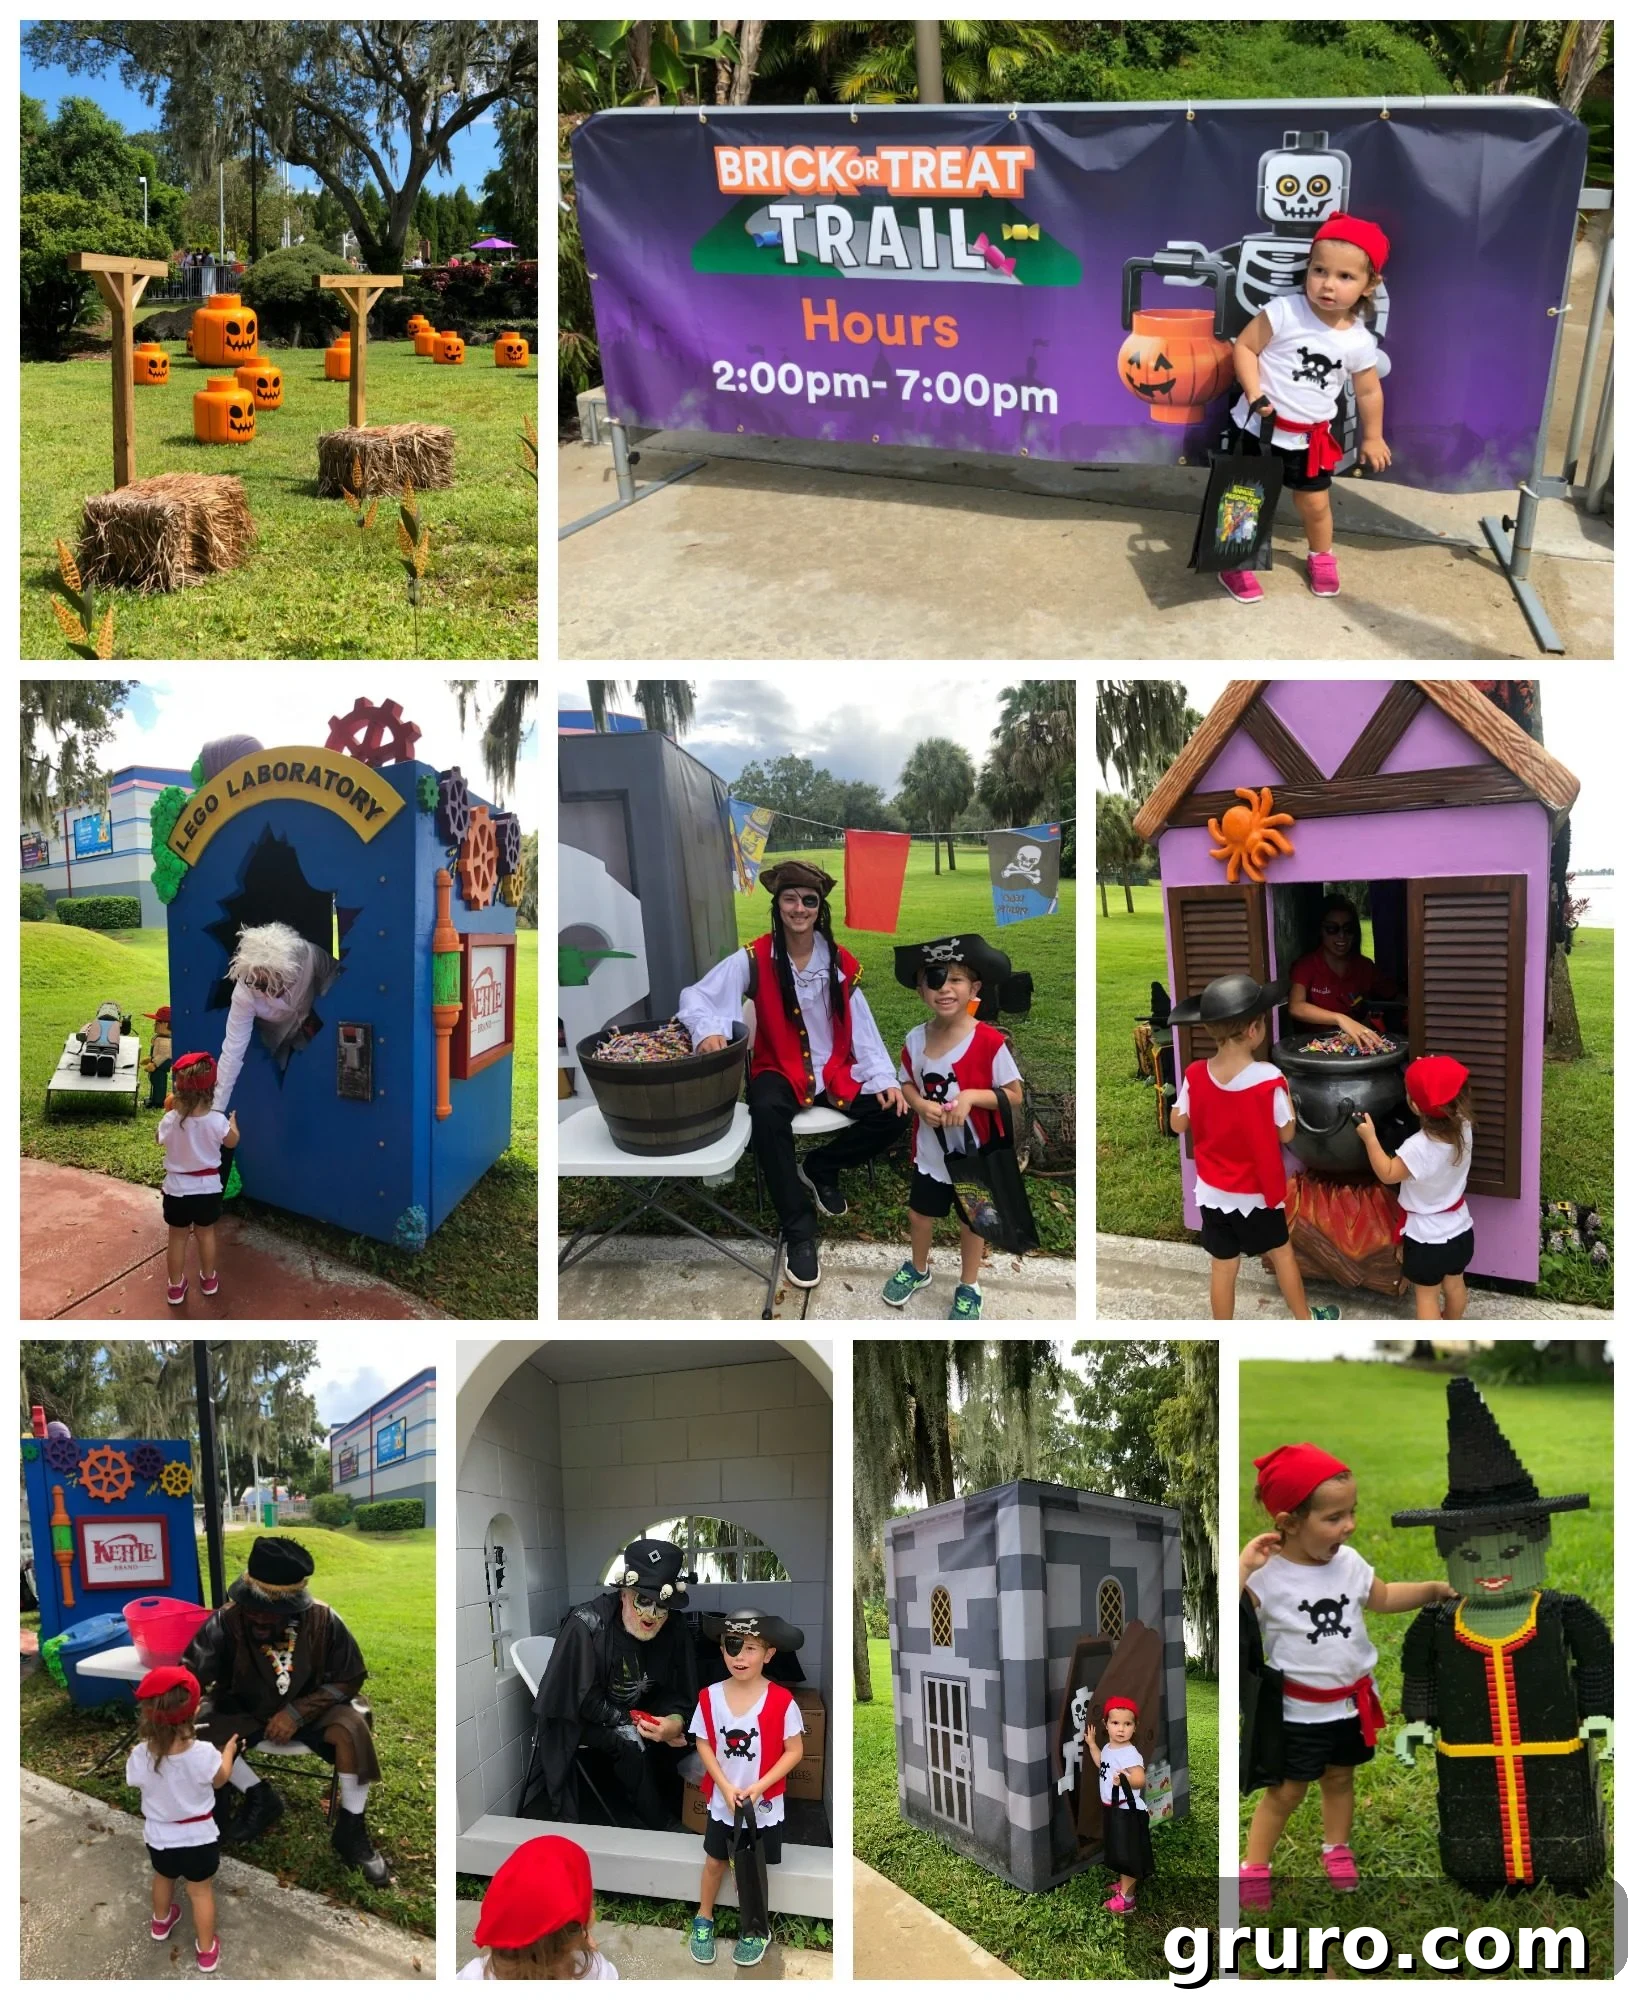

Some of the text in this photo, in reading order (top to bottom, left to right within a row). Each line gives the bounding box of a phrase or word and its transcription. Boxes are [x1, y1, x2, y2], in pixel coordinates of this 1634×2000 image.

[717, 150, 1027, 190] BRICK OR TREAT
[767, 203, 987, 271] TRAIL
[801, 296, 960, 349] Hours
[895, 367, 1059, 418] 7:00pm
[174, 761, 385, 854] LEGO LABORATORY
[91, 1533, 157, 1565] KETTLE
